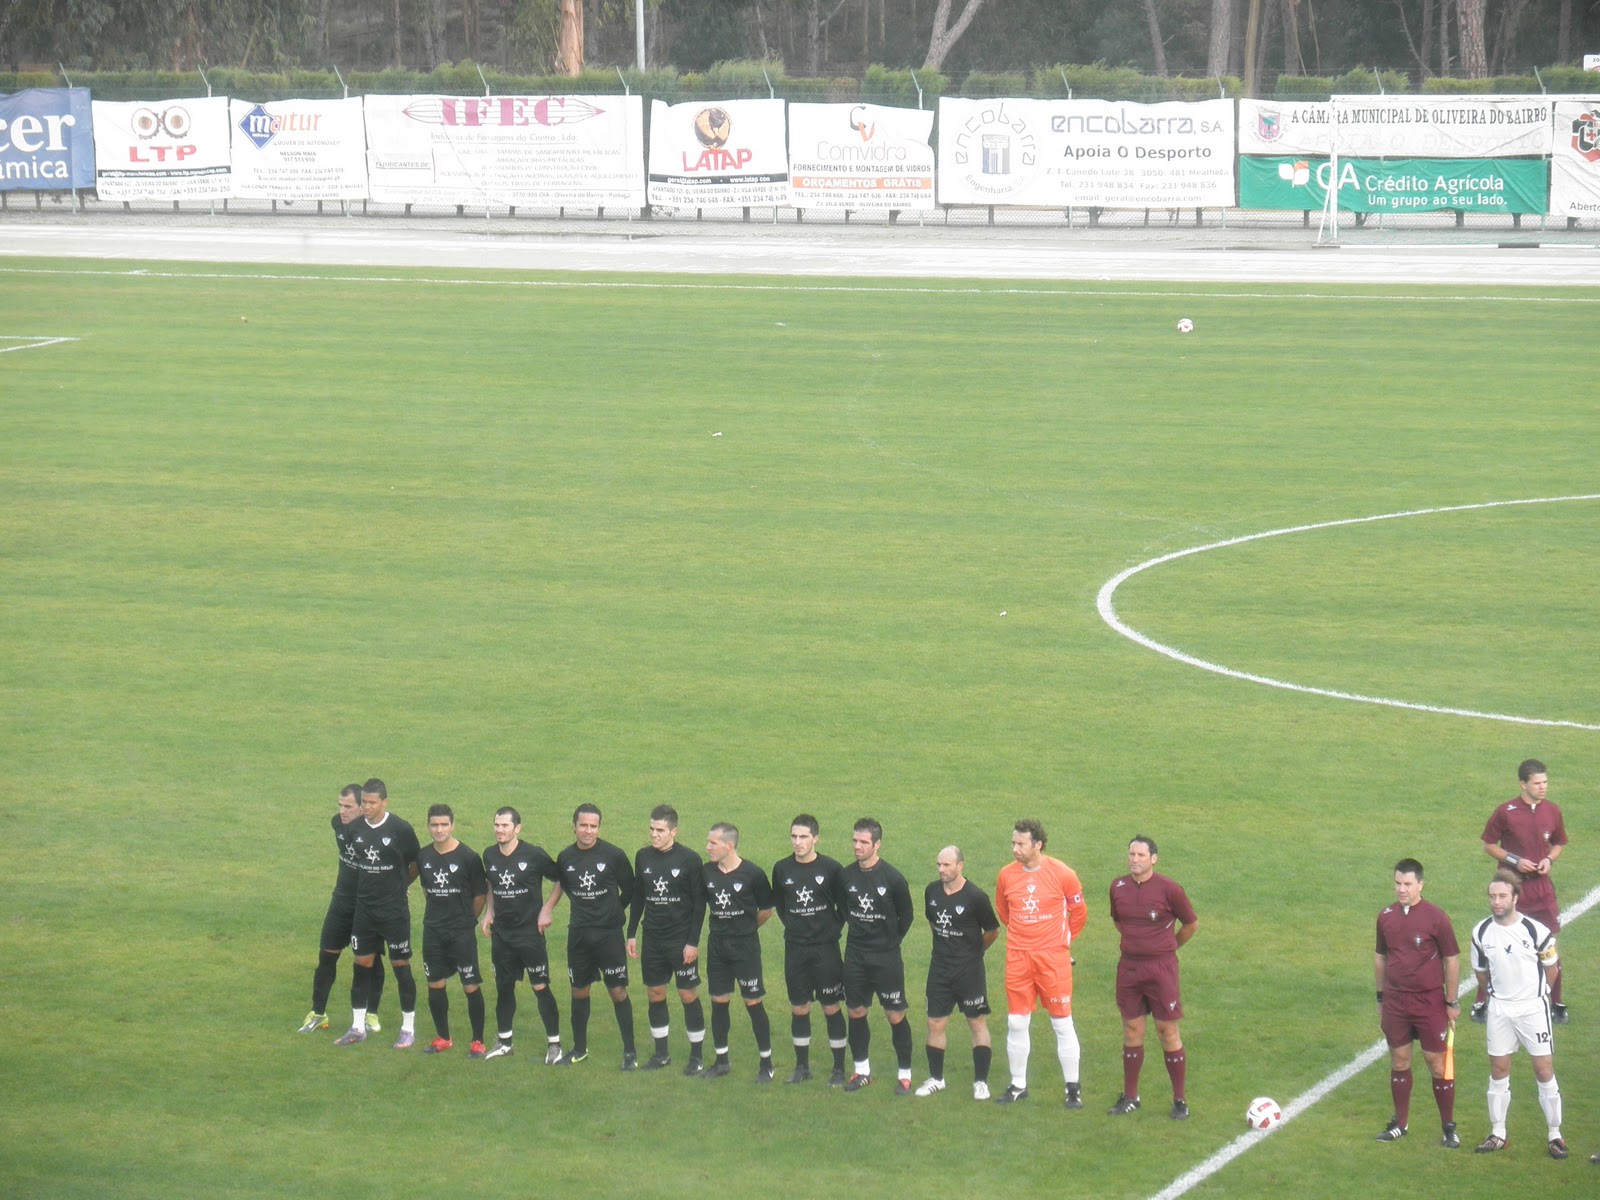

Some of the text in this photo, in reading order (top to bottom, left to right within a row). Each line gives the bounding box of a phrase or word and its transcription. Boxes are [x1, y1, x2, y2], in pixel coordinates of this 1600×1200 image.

[440, 98, 565, 127] IFEC
[1292, 109, 1299, 123] A
[1351, 108, 1412, 124] MUNICIPAL
[1415, 108, 1429, 123] DE
[1432, 109, 1487, 125] OLIVEIRA
[1490, 109, 1504, 124] DO
[1506, 107, 1547, 124] BAIRRO
[249, 112, 323, 133] maitur
[1200, 121, 1225, 133] S.A.
[129, 145, 197, 163] LTP
[817, 140, 907, 161] Comvidro
[1064, 144, 1212, 161] Apoia O Desporto
[683, 148, 753, 172] LATAP
[793, 163, 931, 173] FORNECIMENTO E MONTAGEM DE VIDROS
[802, 177, 922, 190] ORÇAMENTOS GRÁTIS
[1097, 181, 1115, 189] 948
[1117, 182, 1134, 190] 834
[1180, 181, 1198, 189] 948
[1366, 173, 1504, 194] Crédito Agrícola
[1369, 193, 1508, 207] Um grupo ao seu lado.
[1535, 1031, 1550, 1044] 12
